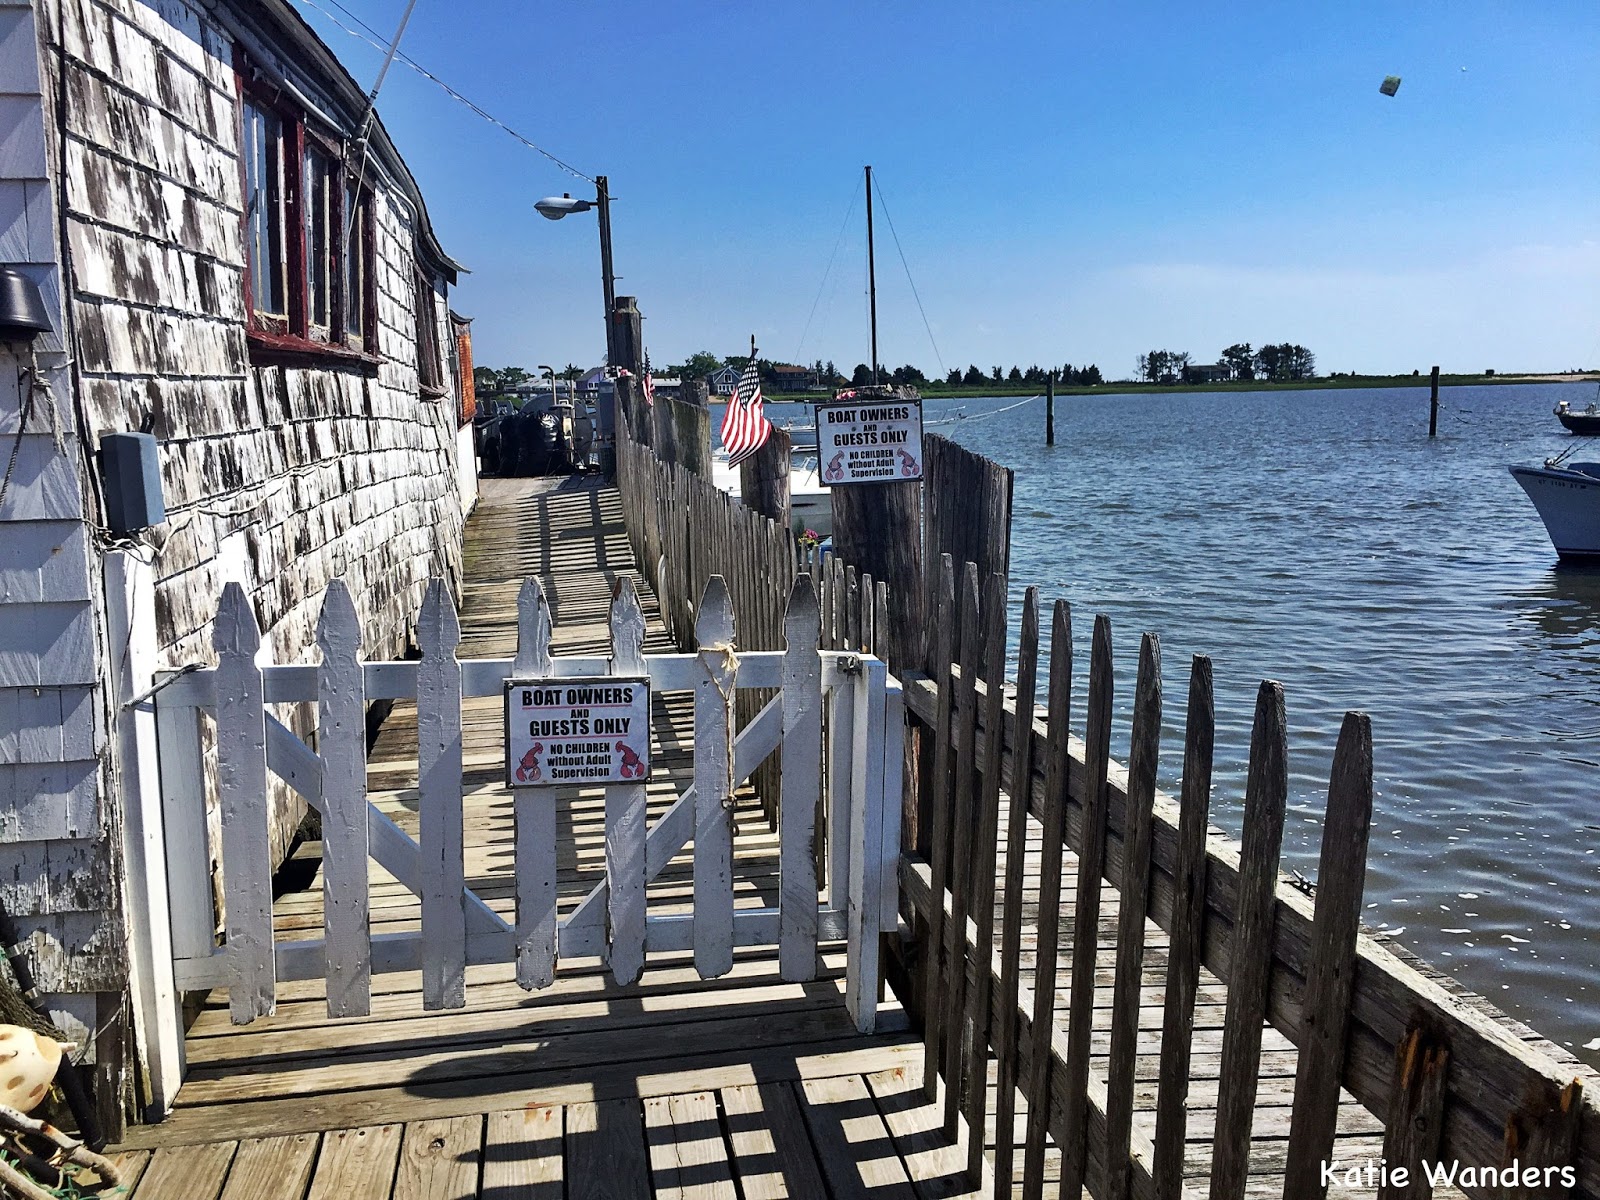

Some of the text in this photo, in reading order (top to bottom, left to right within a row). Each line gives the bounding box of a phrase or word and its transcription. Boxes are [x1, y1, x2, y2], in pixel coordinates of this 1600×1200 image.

[828, 407, 909, 423] BOAT OWNERS
[863, 424, 877, 432] AND
[834, 430, 908, 446] GUESTS ONLY
[849, 449, 894, 460] NO CHILDREN
[848, 458, 895, 469] without Adult
[851, 468, 894, 478] Supervision
[522, 687, 633, 706] BOAT OWNERS
[570, 709, 590, 719] AND
[529, 718, 631, 737] GUESTS ONLY
[550, 742, 610, 755] NO CHILDREN
[547, 754, 612, 767] without Adult
[551, 767, 610, 779] Supervision
